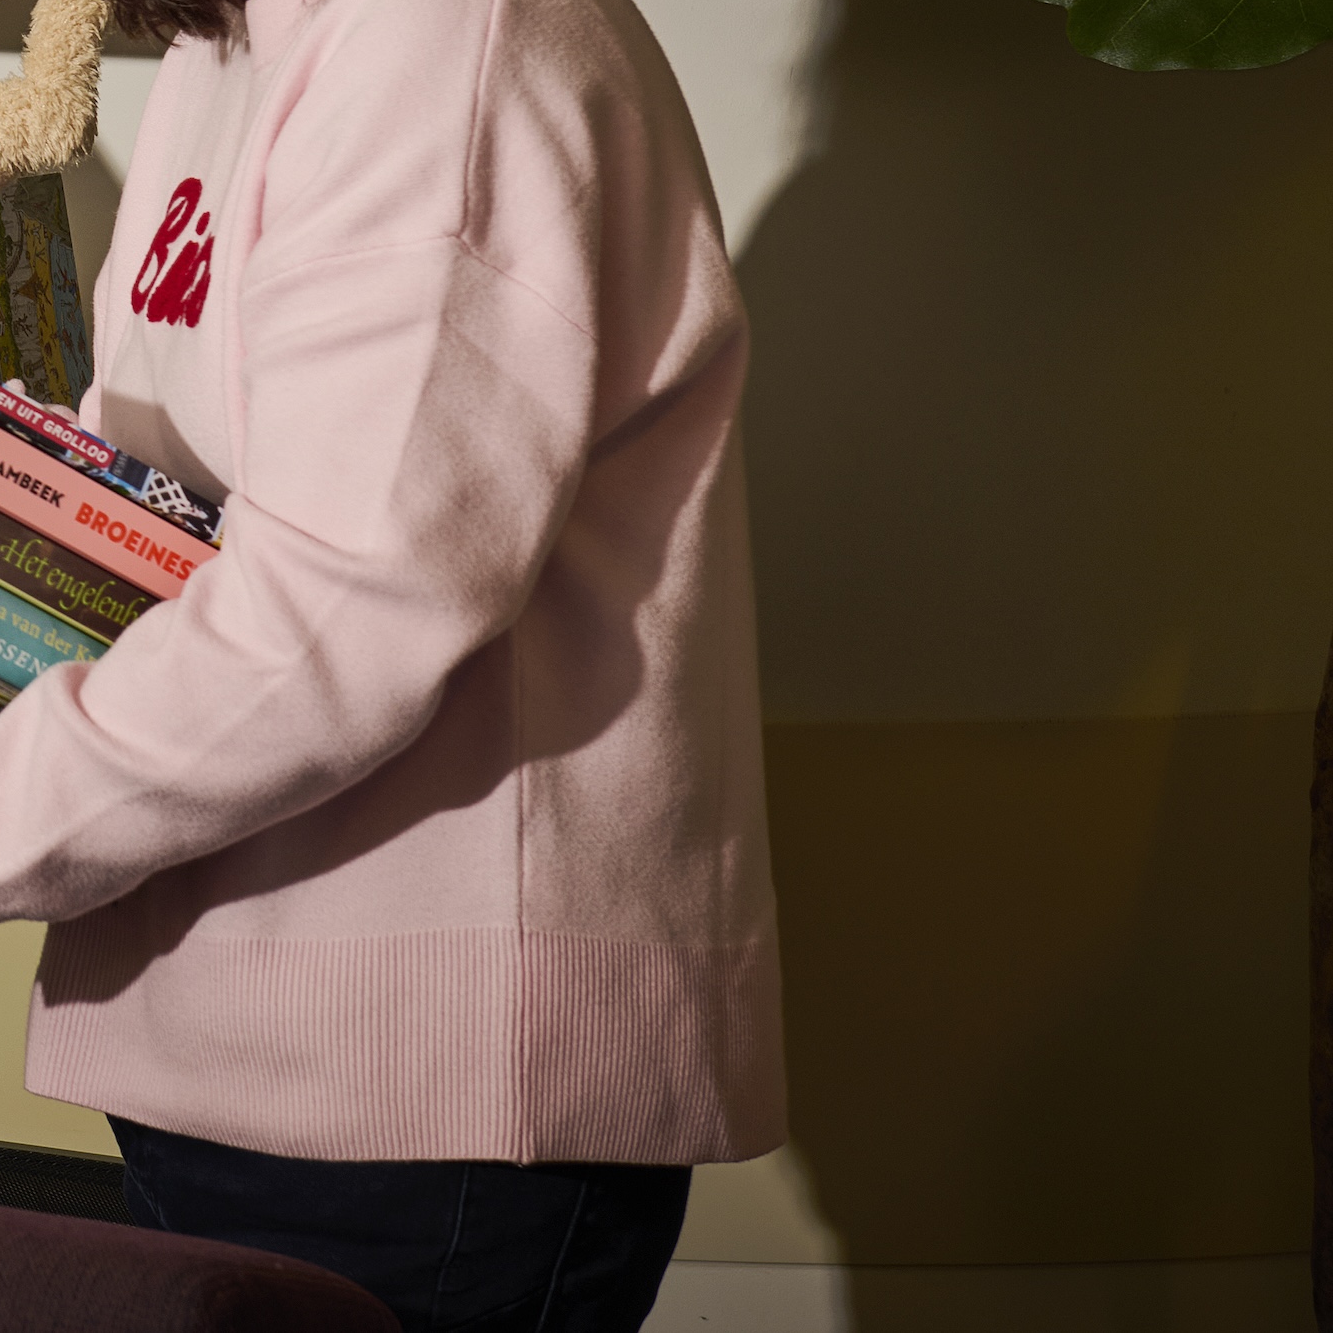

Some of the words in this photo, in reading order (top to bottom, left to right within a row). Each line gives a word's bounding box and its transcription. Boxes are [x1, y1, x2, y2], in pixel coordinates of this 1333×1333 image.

[16, 403, 43, 425] UIT
[42, 416, 110, 464] GROLLOO
[0, 538, 49, 580] Het
[11, 612, 41, 639] van
[43, 628, 72, 655] der
